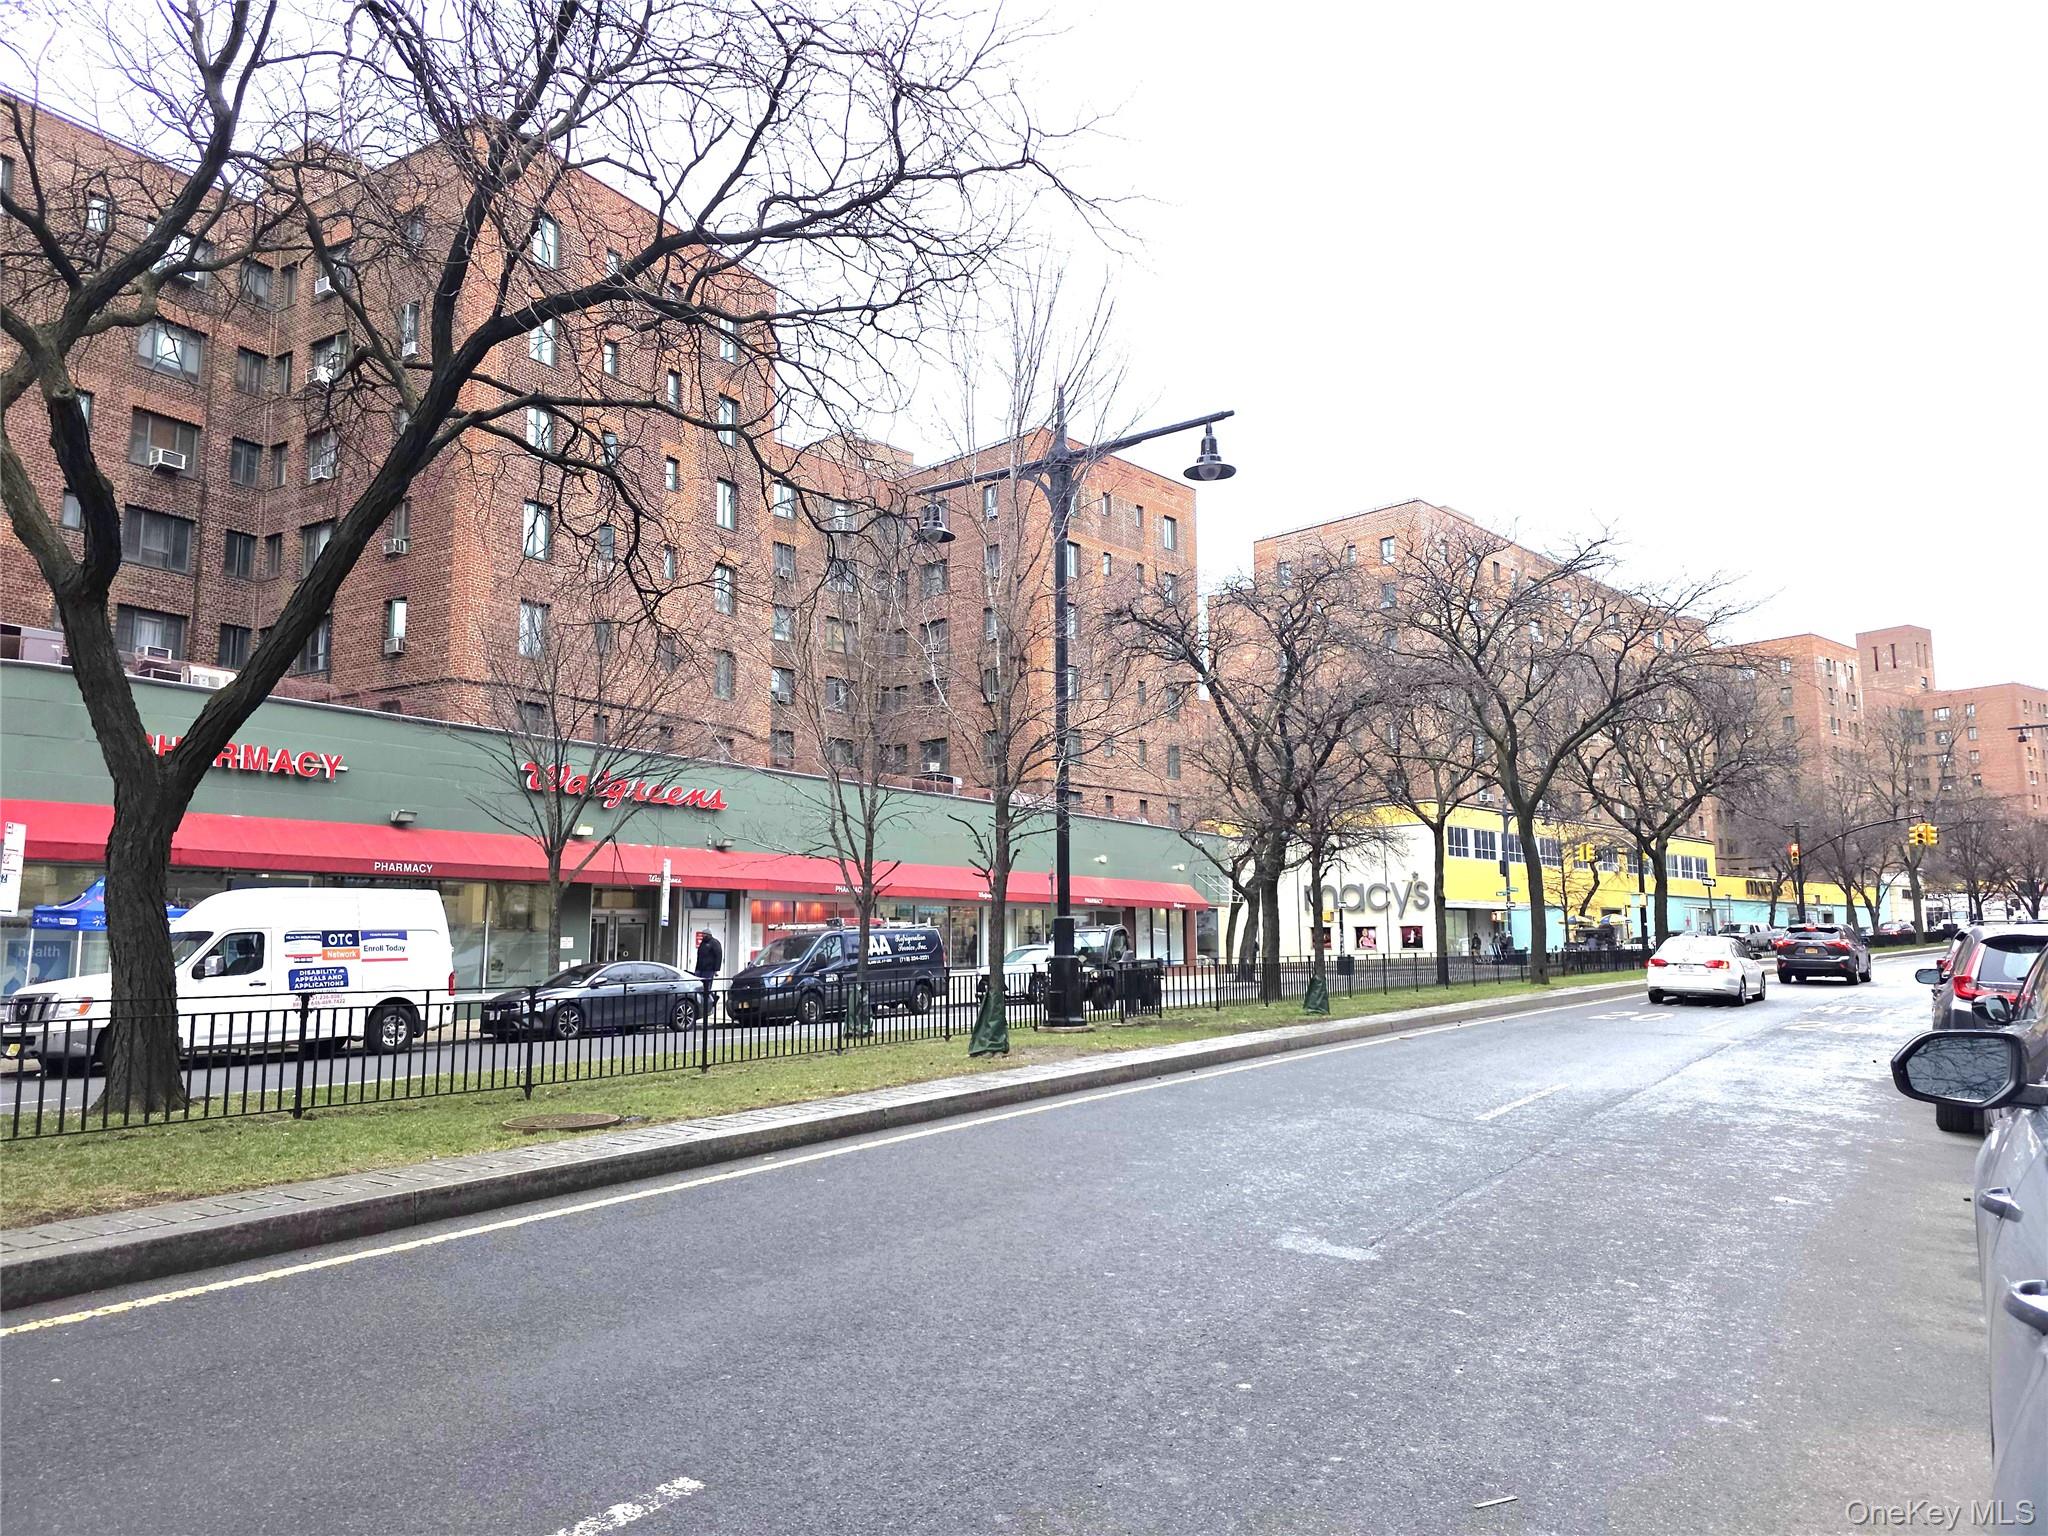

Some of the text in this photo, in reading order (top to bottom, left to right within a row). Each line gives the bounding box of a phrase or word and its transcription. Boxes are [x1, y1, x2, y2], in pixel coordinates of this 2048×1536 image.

[145, 733, 345, 780] HRMACY
[520, 761, 728, 810] Walgreens
[374, 861, 433, 873] PHARMACY
[835, 885, 864, 893] PHAAC
[328, 933, 353, 945] OTC
[363, 944, 406, 953] Enroll Today
[327, 950, 357, 958] Network
[299, 968, 337, 976] DISABILITY
[294, 975, 327, 983] APPEALS
[294, 981, 344, 990] APPLICATIONS
[1588, 1011, 1674, 1021] 20
